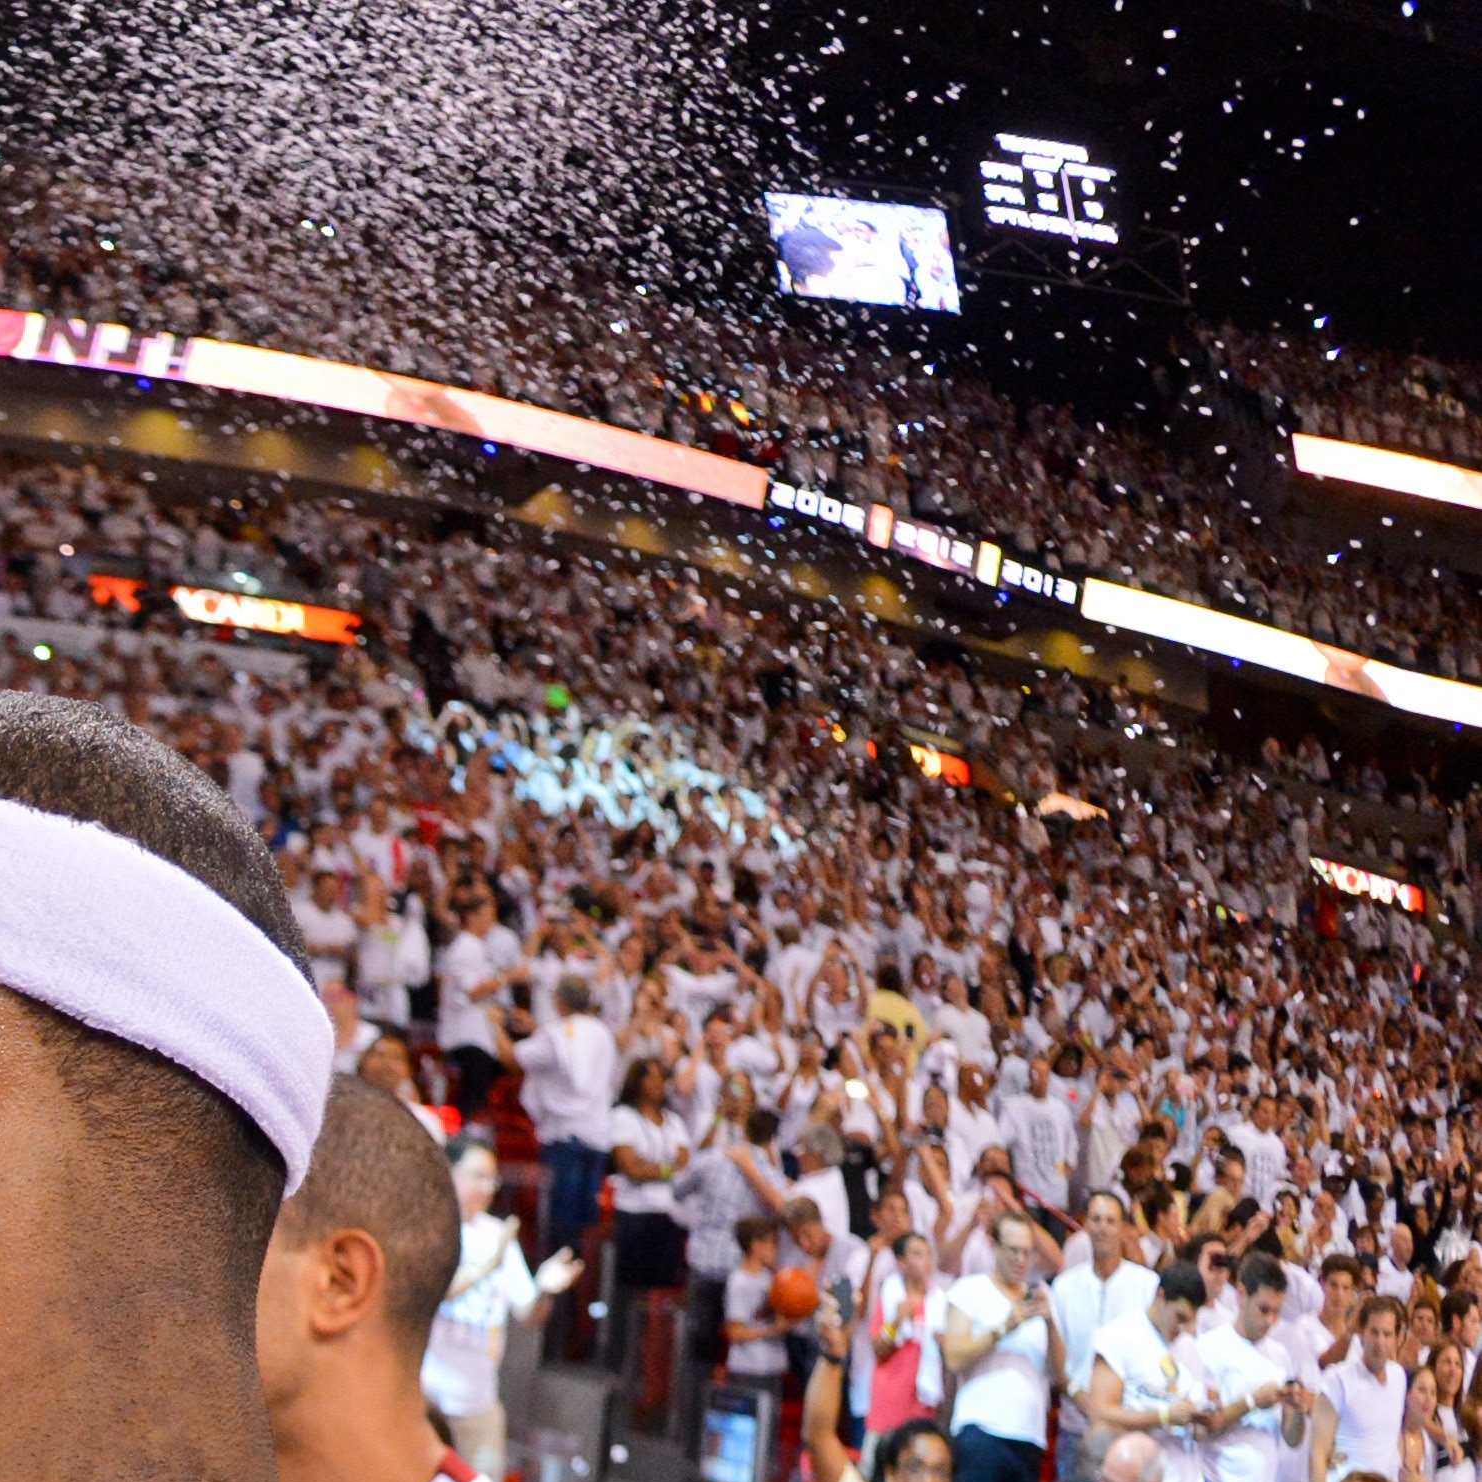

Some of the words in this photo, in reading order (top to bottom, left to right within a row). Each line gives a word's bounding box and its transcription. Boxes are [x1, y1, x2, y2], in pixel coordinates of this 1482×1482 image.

[770, 481, 866, 533] 2006
[893, 520, 975, 568] 2012
[1001, 558, 1078, 606] 2013
